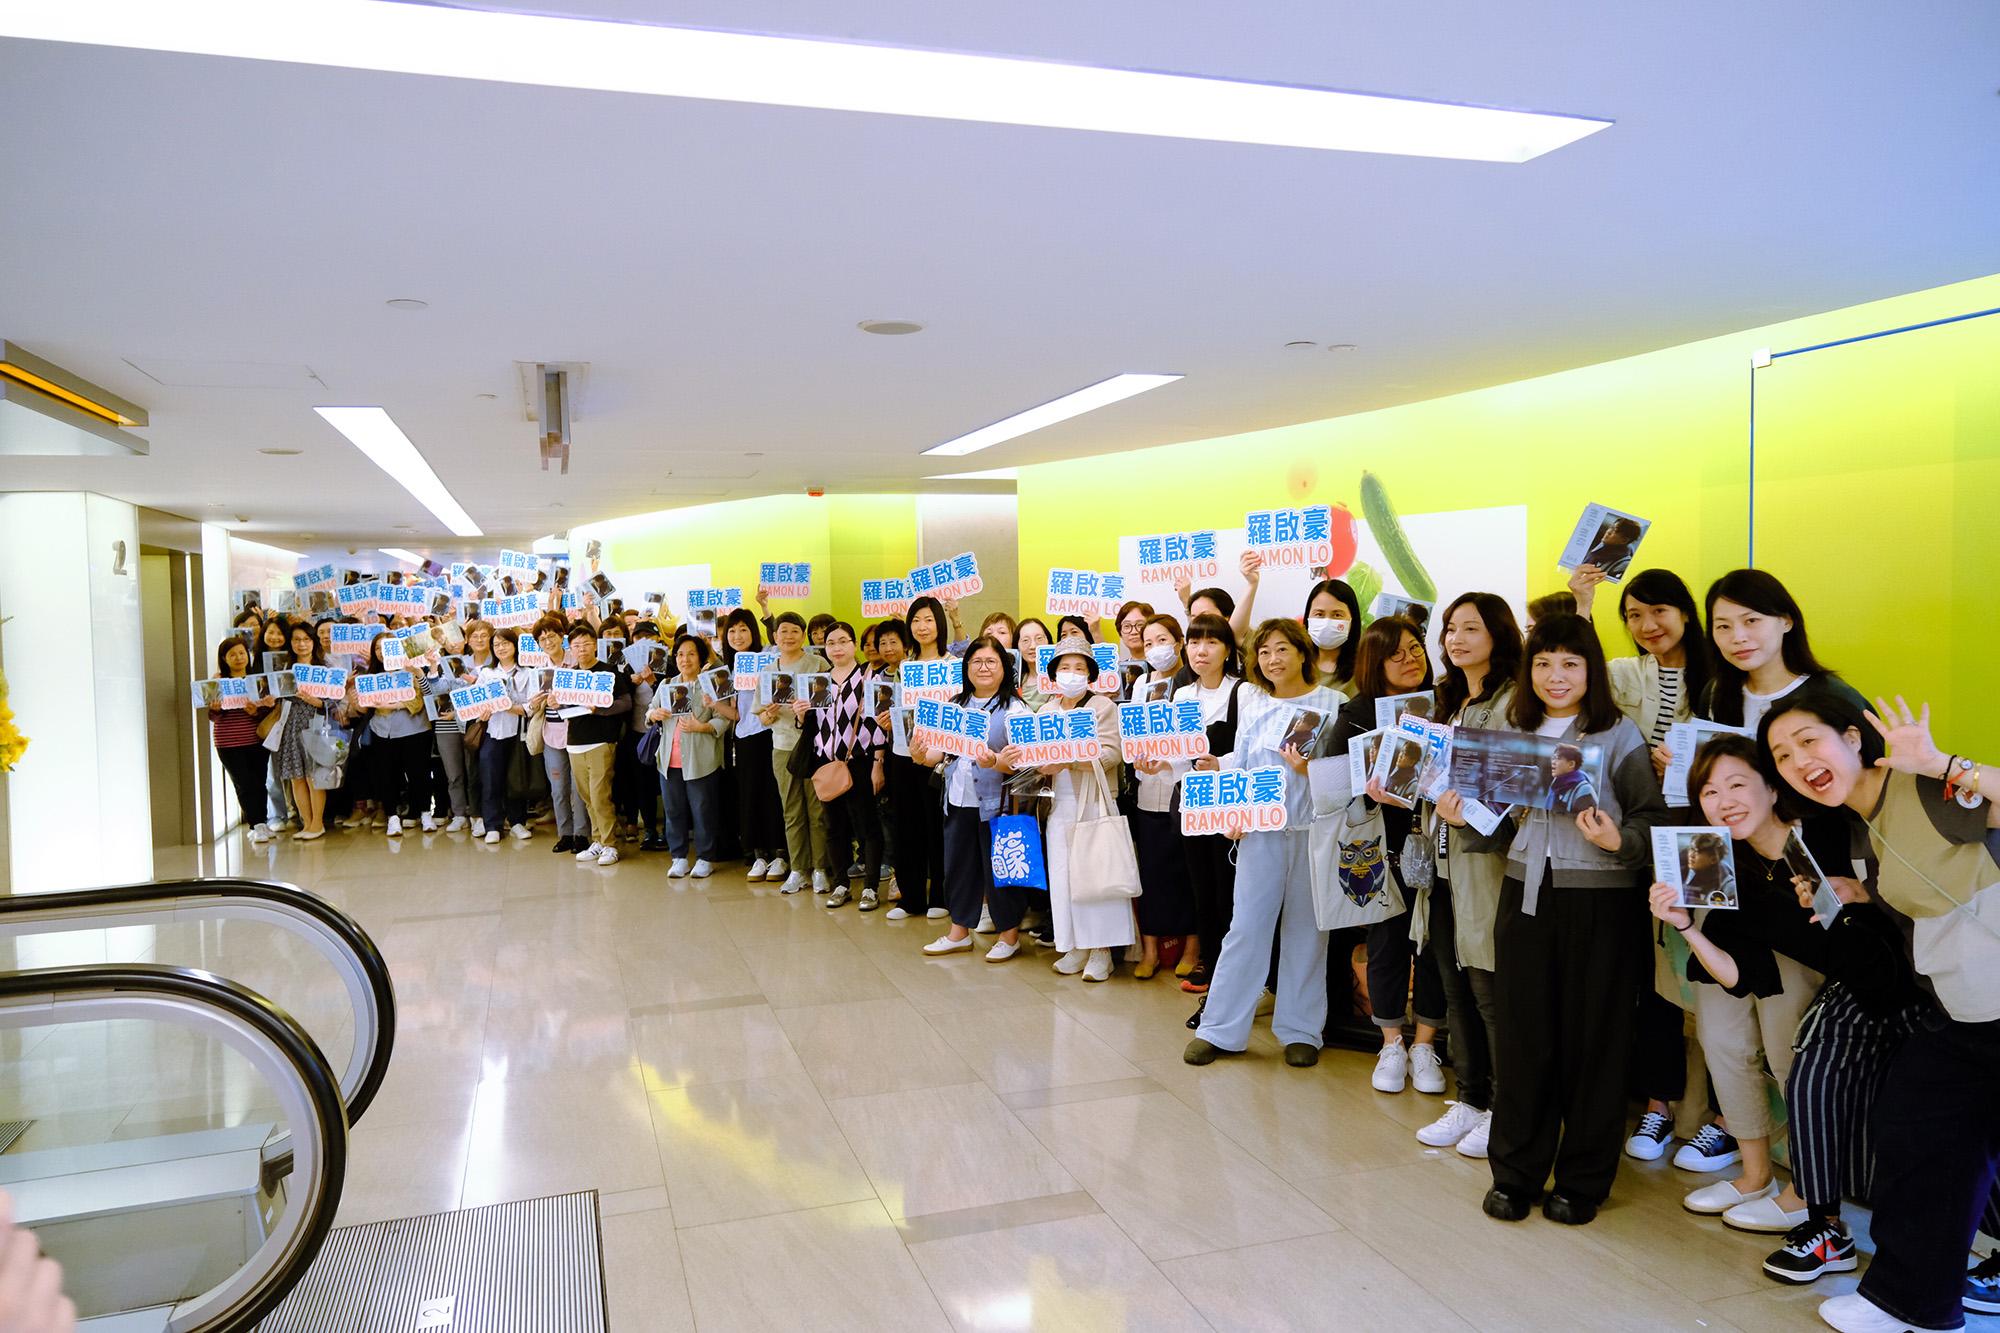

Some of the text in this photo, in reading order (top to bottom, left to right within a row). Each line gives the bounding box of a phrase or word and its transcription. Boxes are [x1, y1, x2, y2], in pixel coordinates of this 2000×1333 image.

[1247, 507, 1329, 546] 羅啟豪
[1138, 532, 1216, 565] 羅啟豪
[1257, 544, 1329, 568] AMON LO
[761, 562, 810, 583] 羅啟豪
[910, 554, 976, 592] 羅啟豪
[1141, 561, 1217, 583] RAMON LO
[797, 585, 809, 596] LO
[863, 580, 915, 601] 羅啟
[963, 578, 980, 593] LO
[1050, 571, 1125, 599] 羅啟豪
[414, 604, 425, 614] LO
[689, 588, 742, 608] 羅啟豪
[330, 686, 344, 697] LO
[357, 672, 411, 693] 羅啟豪
[556, 670, 612, 692] 羅啟豪
[359, 689, 414, 705] RAMON LO
[453, 681, 505, 707] 羅啟豪
[496, 698, 509, 711] LO
[555, 691, 611, 705] RAMON LO
[917, 699, 987, 740] 羅啟豪
[1009, 711, 1095, 745] 羅啟豪
[1121, 701, 1203, 737] 羅啟豪
[967, 739, 986, 757] LO
[1076, 741, 1099, 759] LO
[1124, 735, 1208, 760] RAMON LO
[1184, 769, 1283, 808] 羅啟豪
[1185, 807, 1284, 832] RAMON LO
